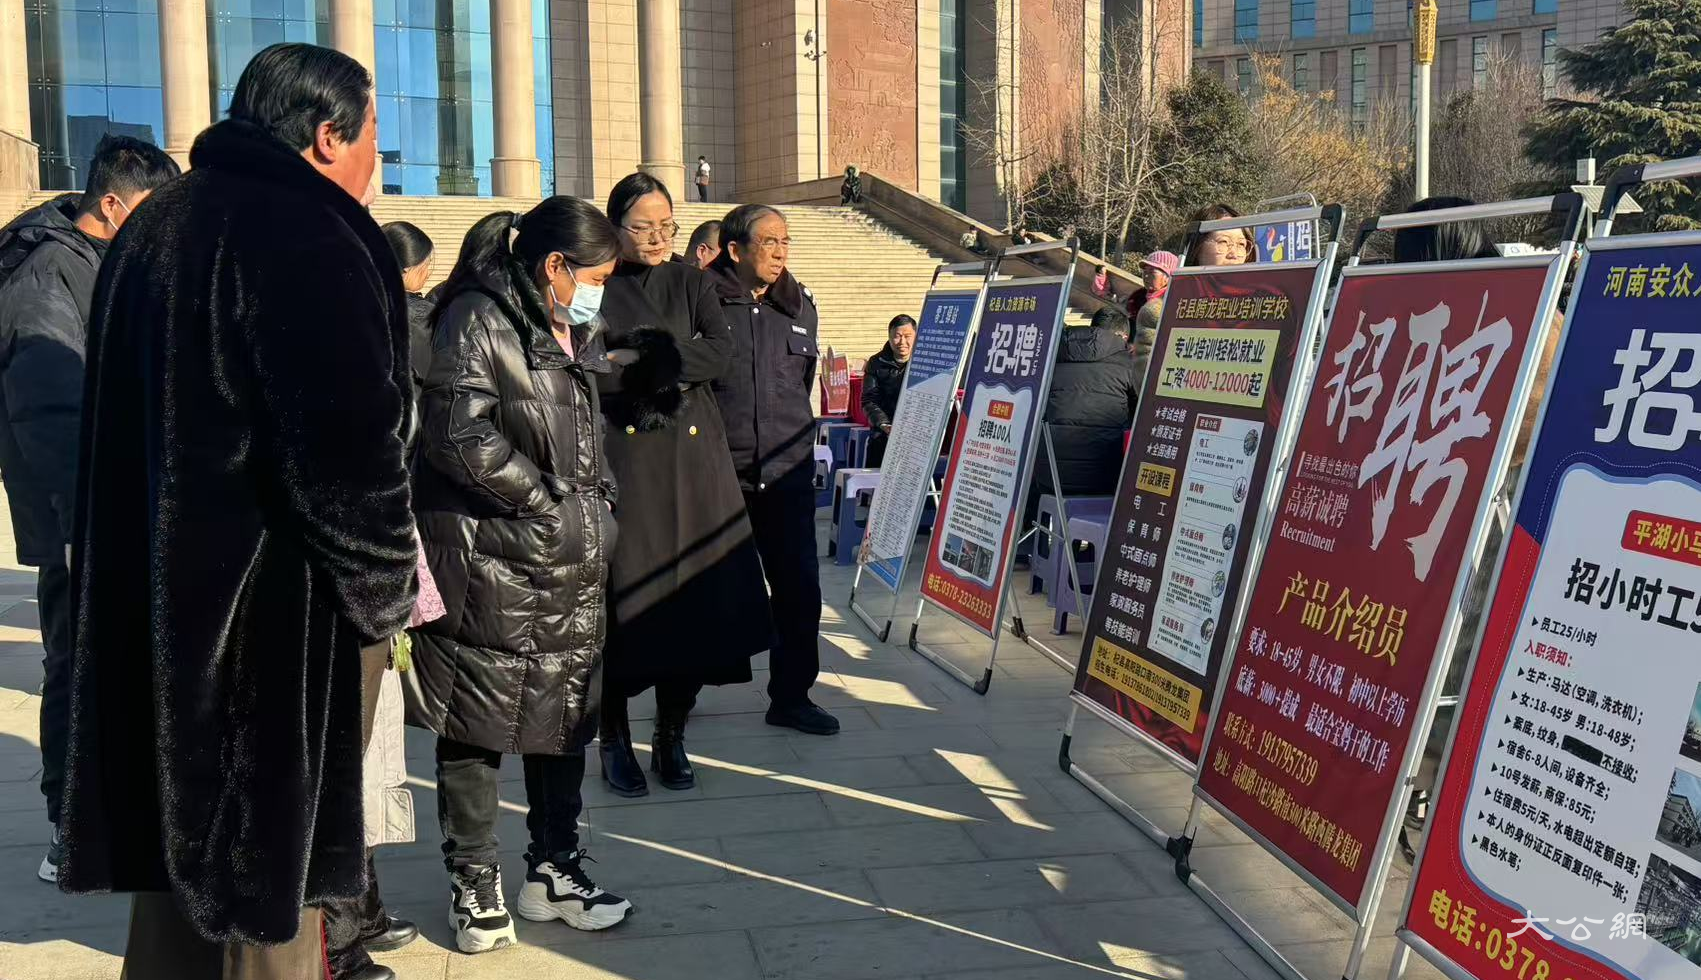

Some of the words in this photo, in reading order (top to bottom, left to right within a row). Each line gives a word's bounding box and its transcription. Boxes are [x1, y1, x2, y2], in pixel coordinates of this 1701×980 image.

[1175, 296, 1289, 321] 杞县腾龙职业培训学校
[984, 322, 1038, 376] 招聘
[1174, 336, 1266, 363] 专业培训轻松就业
[1161, 367, 1264, 397] 工资4000-12000起
[978, 419, 1012, 443] 招聘100人
[1324, 289, 1513, 582] 招聘
[1140, 468, 1171, 490] 开设课程
[1284, 482, 1350, 529] 高薪诚聘
[1280, 520, 1336, 552] Recruitment
[1120, 543, 1159, 569] 中式面点师
[1115, 567, 1153, 595] 养老护理师
[1109, 592, 1146, 621] 家政服务员
[1276, 570, 1408, 667] 产品介绍员
[1104, 616, 1141, 646] 等技能培训
[1540, 616, 1598, 647] 员工25/小时
[1523, 639, 1574, 668] 入职须知:
[1304, 702, 1391, 774] 最适合宝妈干的工作
[1506, 739, 1611, 800] 宿舍6-8人间,设备齐全;
[1500, 764, 1597, 824] 10号发薪,商保:85元;
[1493, 787, 1641, 878] 住宿费5元/天,水电超出定额自理;
[1479, 836, 1523, 872] 黑色水笔;
[1486, 812, 1629, 904] 本人的身份证正反面复印件一张;
[1427, 888, 1573, 980] 电话:0378
